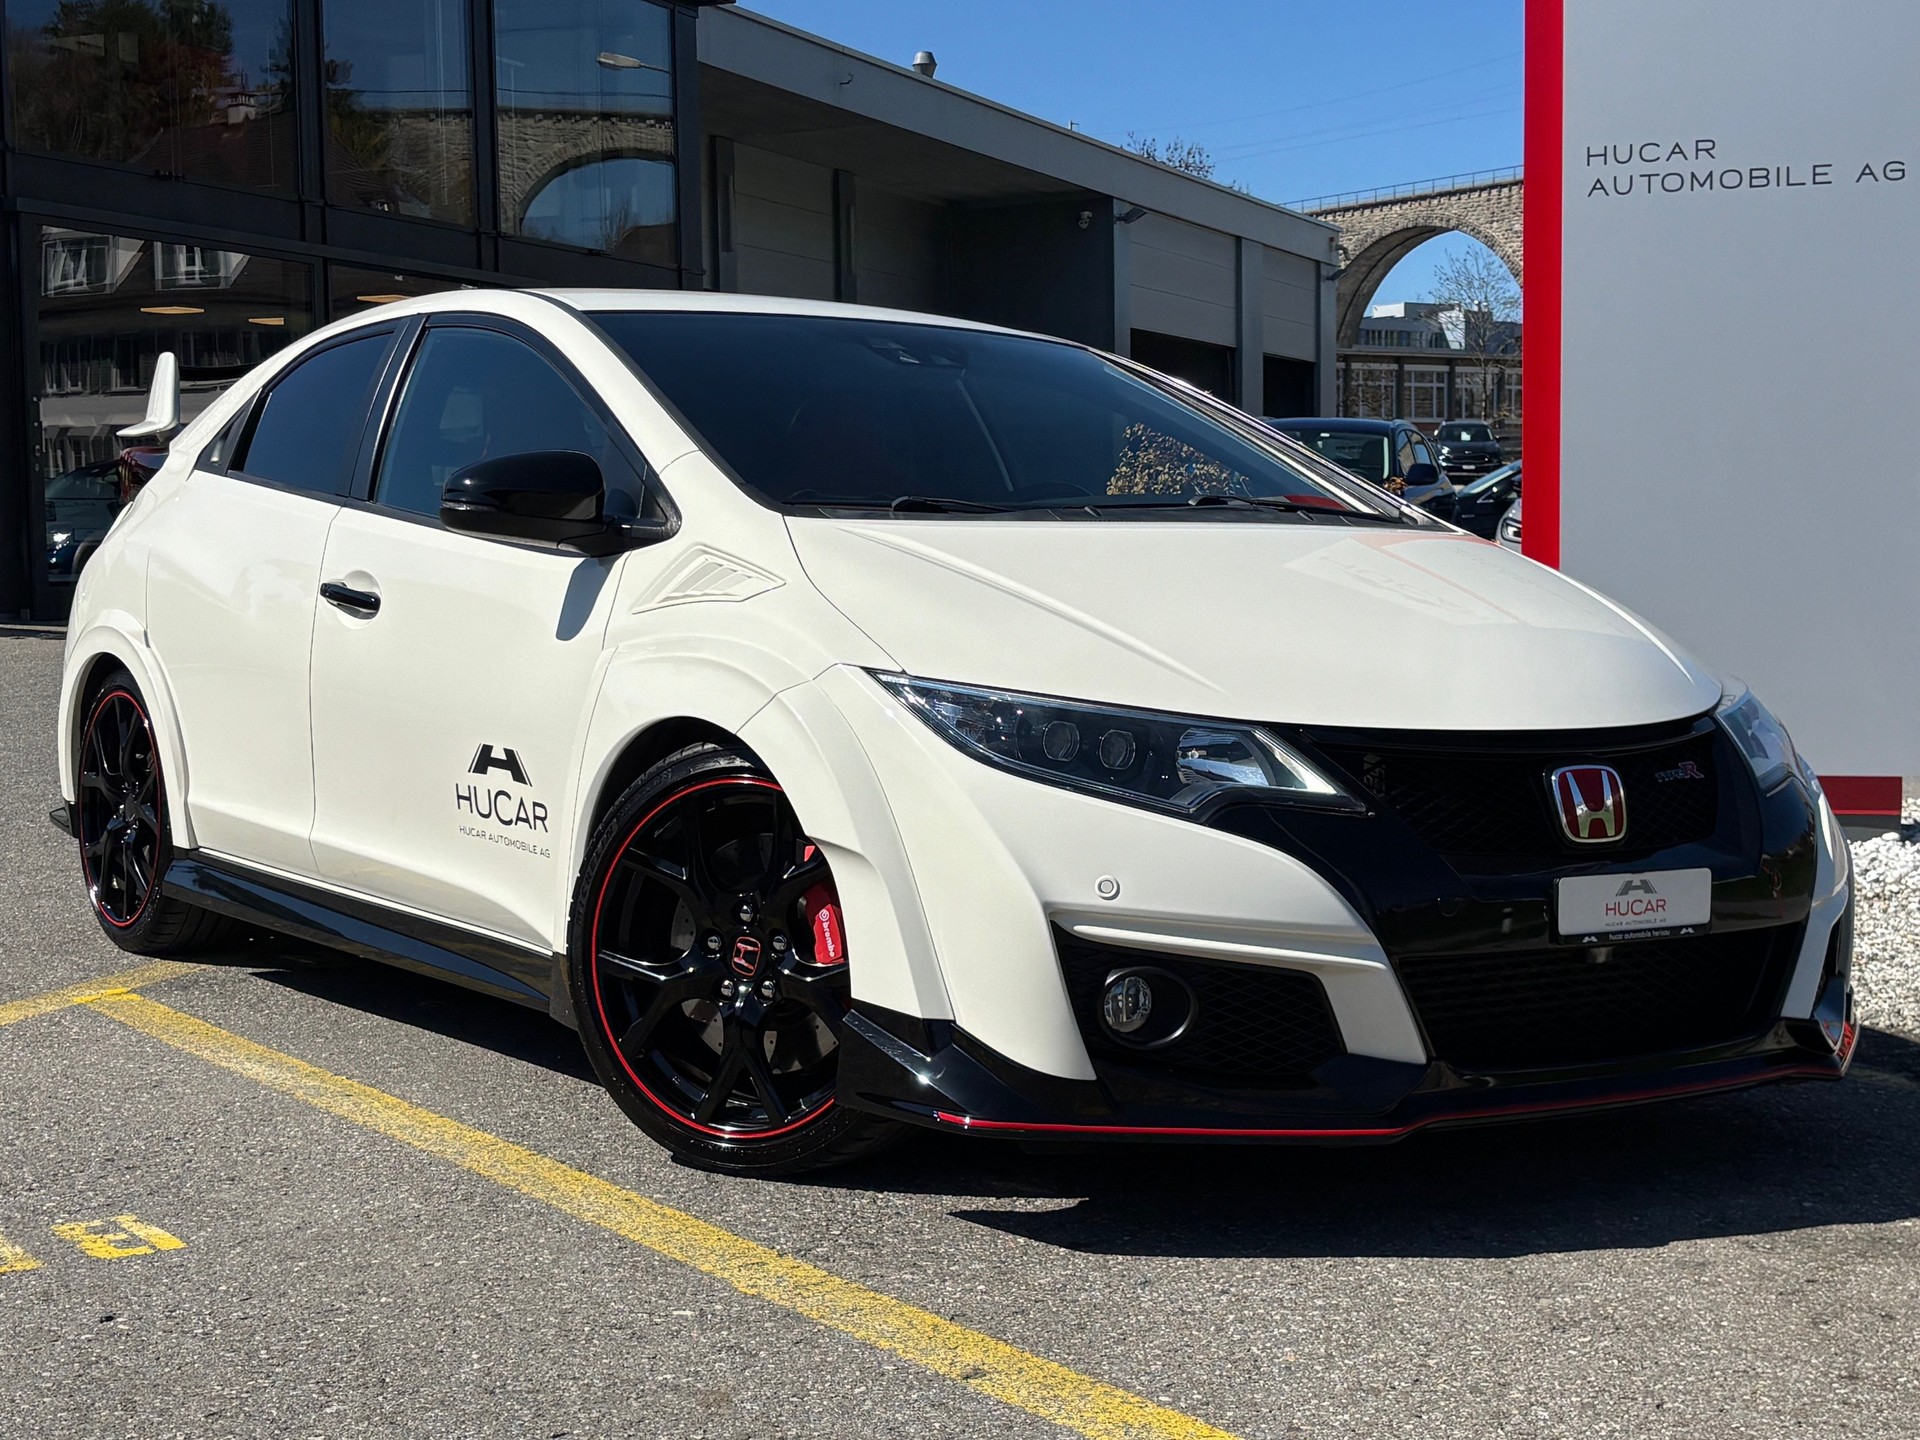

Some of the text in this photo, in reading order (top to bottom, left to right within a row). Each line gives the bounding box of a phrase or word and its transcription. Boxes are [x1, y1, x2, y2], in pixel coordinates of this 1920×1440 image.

[1586, 139, 1716, 167] HUCAR
[1587, 161, 1906, 197] AUTOMOBILE AG
[455, 783, 549, 833] HUCAR
[459, 825, 551, 859] HUCAR AUTOMOBILE AG
[1605, 898, 1667, 917] HUCAR
[822, 921, 836, 958] brembo
[1624, 931, 1651, 939] automobile
